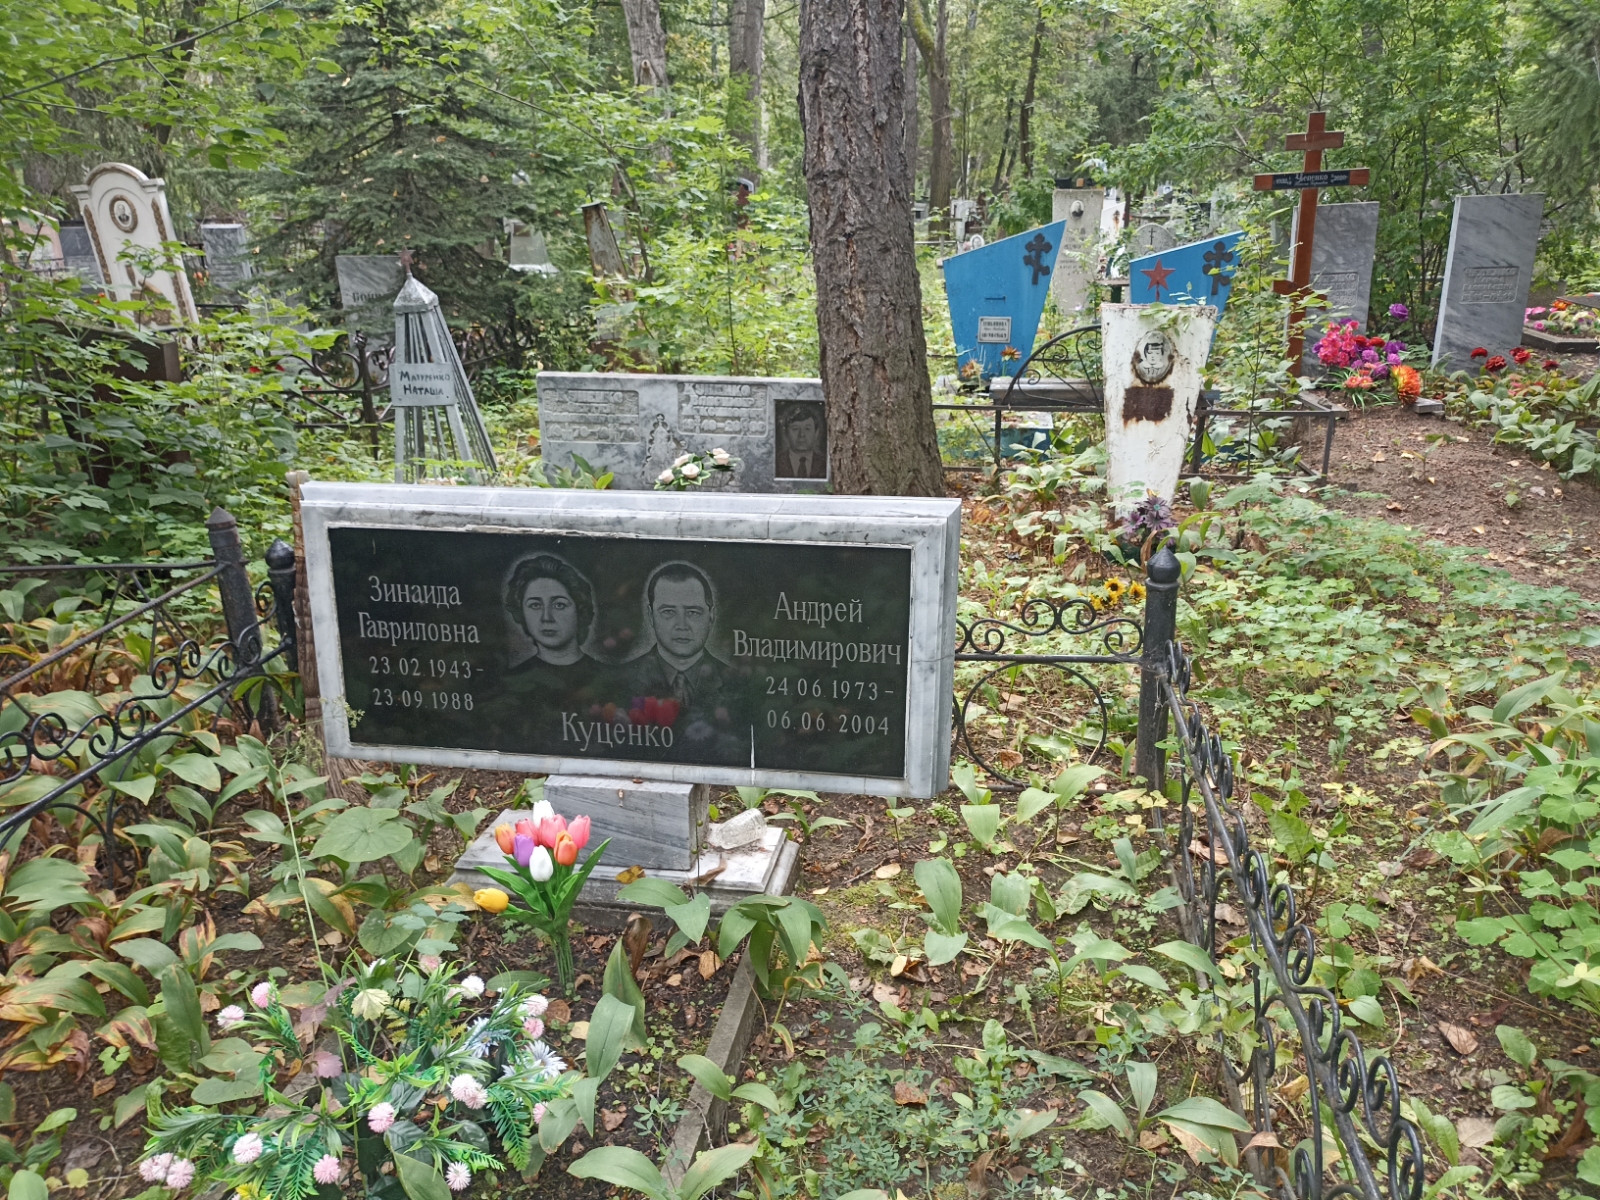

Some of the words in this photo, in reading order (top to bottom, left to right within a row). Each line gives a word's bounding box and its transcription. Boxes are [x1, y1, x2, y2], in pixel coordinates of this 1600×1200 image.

[367, 574, 463, 607] Зинаида
[773, 591, 863, 629] Андрей
[357, 611, 481, 647] Гавриловна
[732, 629, 902, 669] Владимирович
[372, 687, 475, 712] 23.09.1988
[560, 711, 674, 752] Куценко
[766, 709, 889, 736] 06.06.2004
